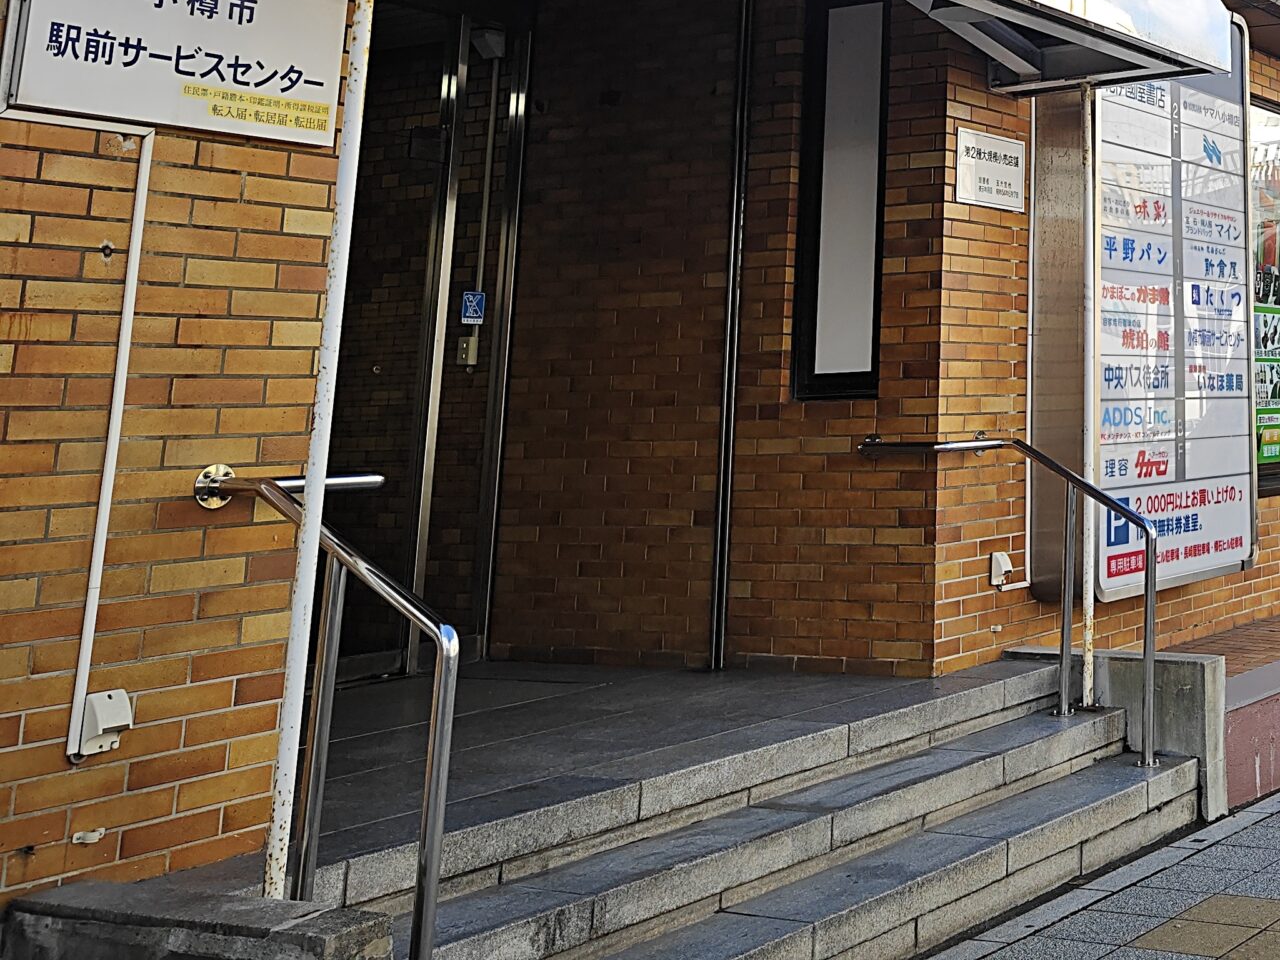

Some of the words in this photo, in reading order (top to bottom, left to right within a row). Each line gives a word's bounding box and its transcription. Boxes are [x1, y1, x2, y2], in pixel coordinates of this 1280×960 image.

[46, 21, 325, 93] 駅前サービスセンター
[1105, 82, 1165, 108] 國屋書店
[1214, 224, 1242, 240] マイン
[1103, 235, 1168, 265] 平野パン
[1204, 258, 1239, 280] 新倉屋
[1122, 329, 1170, 351] 琥珀の館
[1104, 363, 1169, 390] 中央バス待合所
[1197, 373, 1243, 392] いなほ薬局
[1101, 406, 1143, 427] ADDS
[1147, 406, 1171, 425] Inc.
[1104, 458, 1129, 477] 理容
